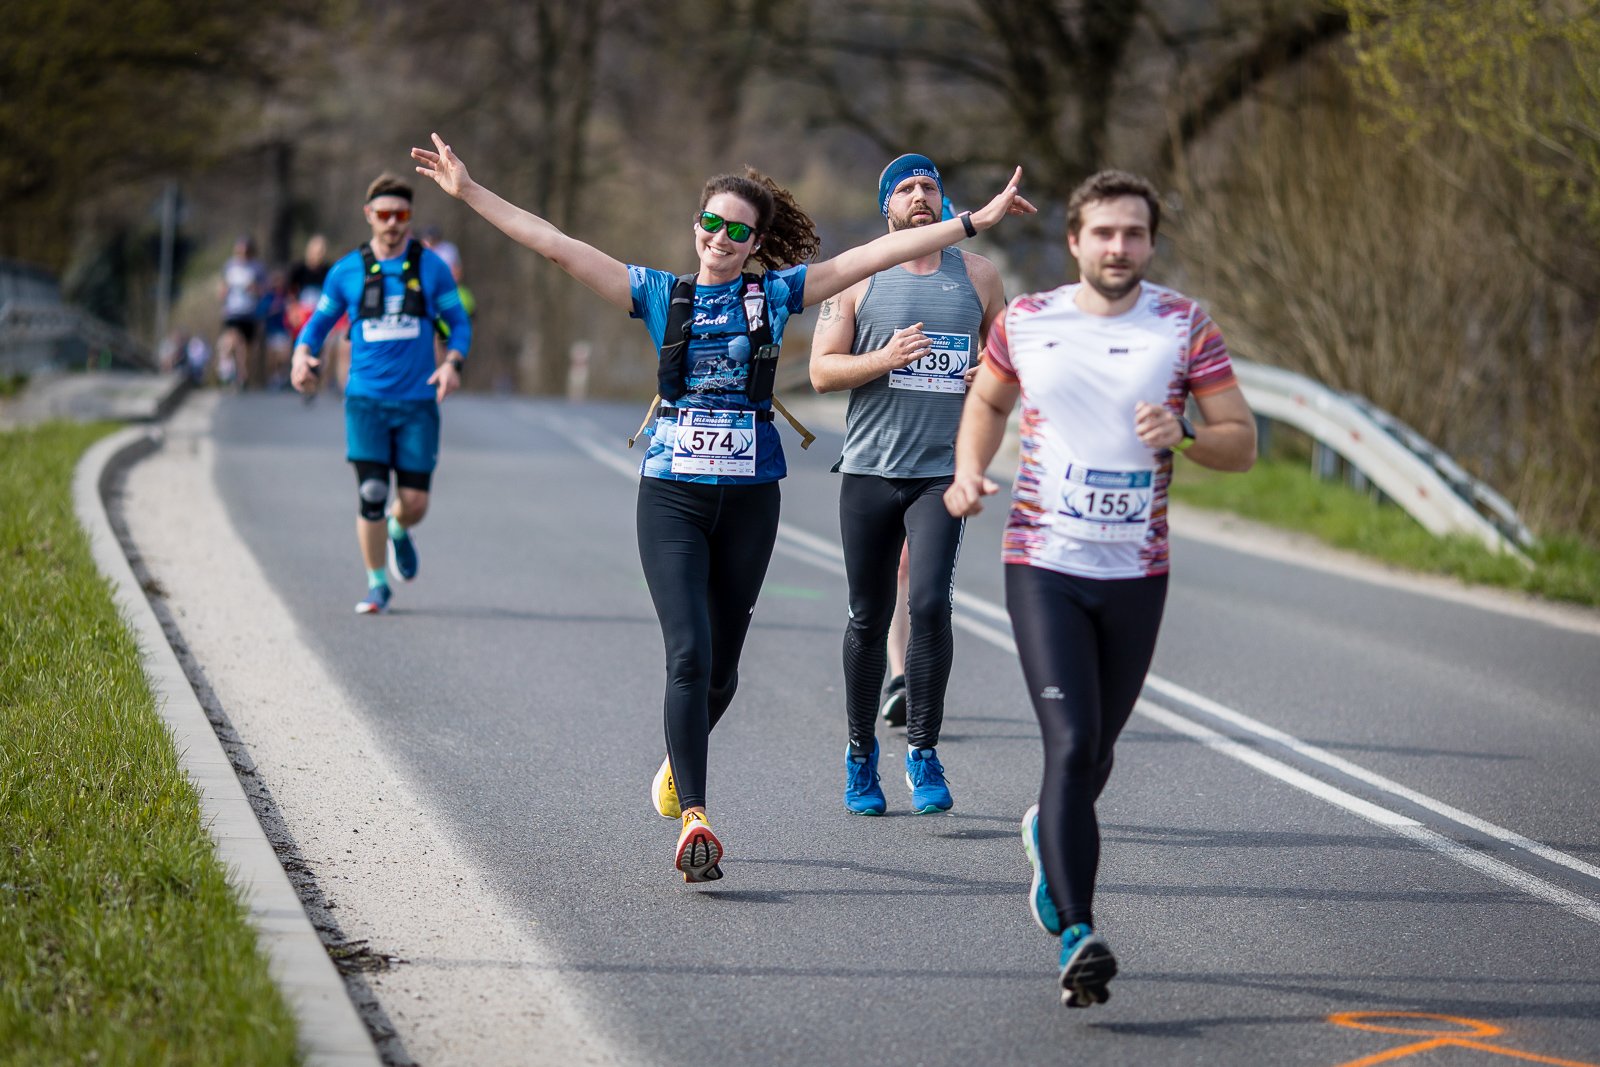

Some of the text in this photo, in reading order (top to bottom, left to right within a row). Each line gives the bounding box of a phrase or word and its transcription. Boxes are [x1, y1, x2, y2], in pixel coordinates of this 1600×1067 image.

[917, 352, 950, 371] 139
[692, 431, 734, 452] 574
[1085, 492, 1129, 515] 155
